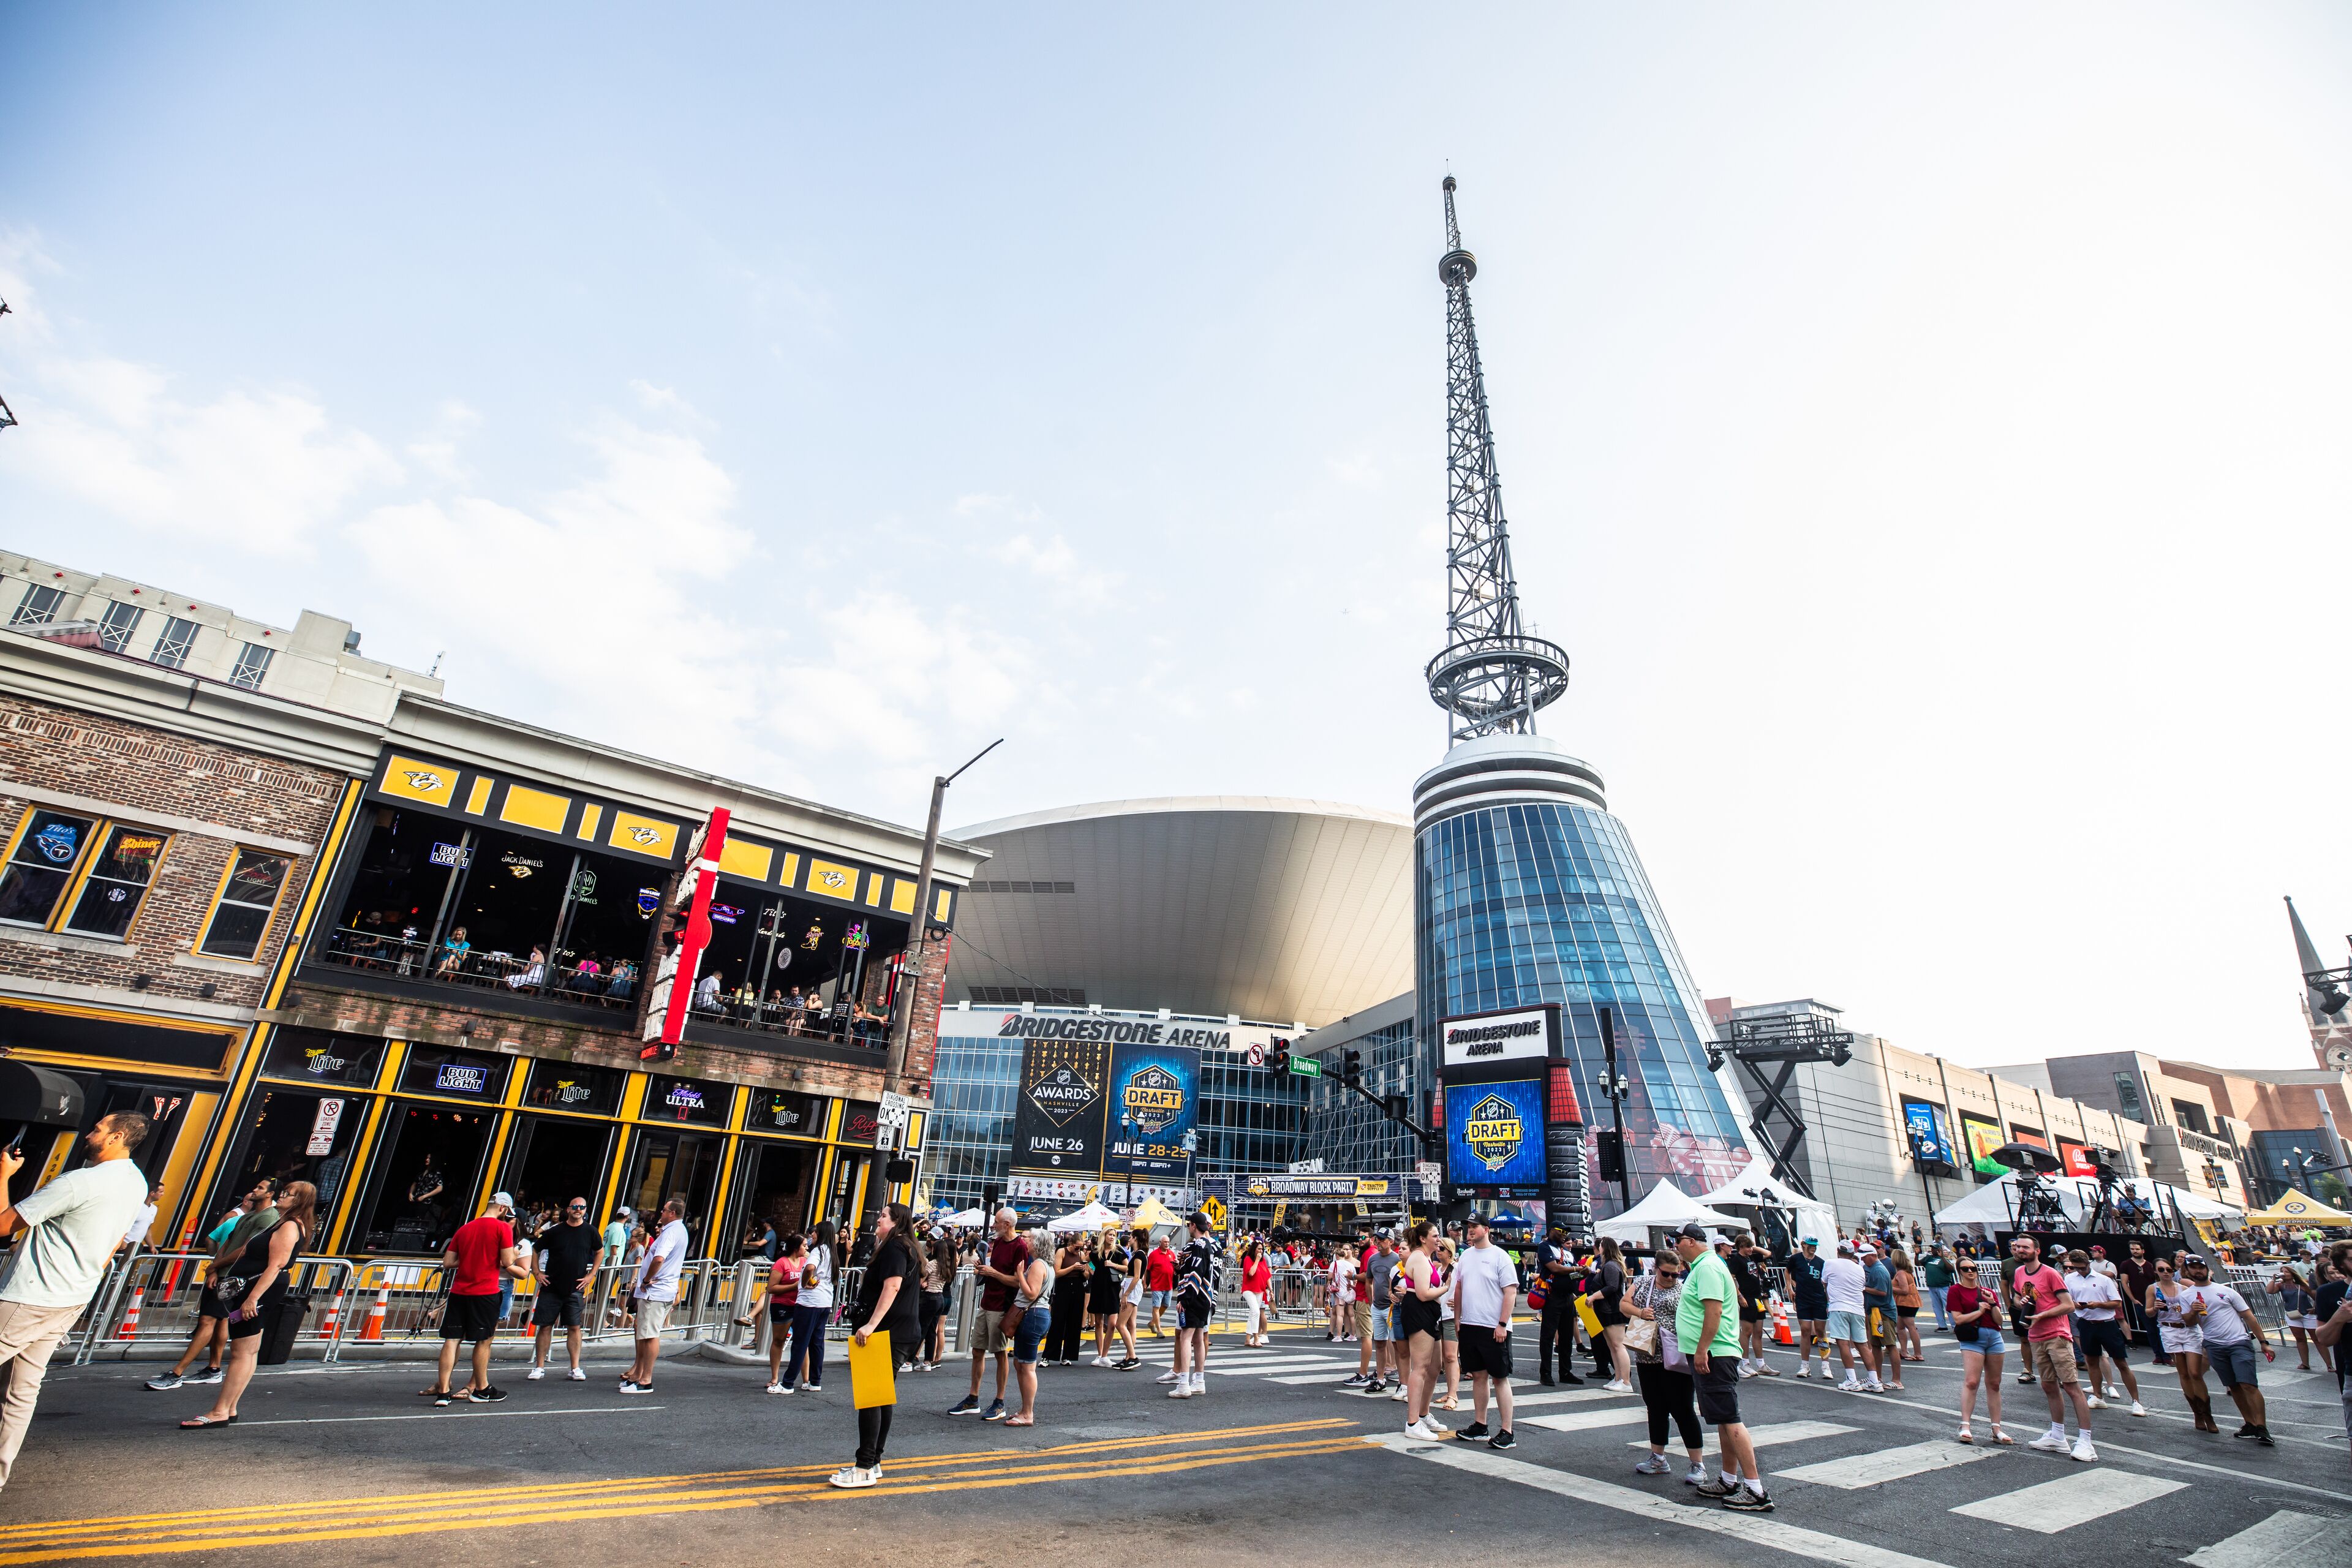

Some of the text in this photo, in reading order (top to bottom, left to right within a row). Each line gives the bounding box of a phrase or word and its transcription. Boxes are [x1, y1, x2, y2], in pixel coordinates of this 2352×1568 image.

[47, 824, 75, 834] Tito's
[121, 838, 161, 849] Shiner
[502, 855, 518, 864] JACK
[763, 908, 786, 919] Tit's
[758, 928, 785, 938] Handade
[556, 948, 576, 957] Tto's
[998, 1014, 1231, 1049] BRIDGESTONE ARENA
[1446, 1020, 1541, 1044] BRIDGESTONE
[1466, 1041, 1503, 1057] ARENA
[307, 1055, 344, 1072] Lite
[1294, 1057, 1317, 1076] Broadway
[447, 1068, 477, 1079] BUD
[439, 1077, 481, 1089] LIGHT
[561, 1085, 590, 1103] Lite
[886, 1093, 906, 1104] DIAGONAL
[1033, 1086, 1091, 1101] AWARDS
[1129, 1090, 1179, 1106] DRAFT
[666, 1095, 704, 1108] ULTRA
[884, 1099, 904, 1109] CROSSING
[775, 1110, 799, 1126] Lite
[880, 1107, 891, 1120] OK
[1472, 1123, 1517, 1138] DRAFT
[1028, 1136, 1084, 1151] JUNE 26
[1148, 1144, 1188, 1158] 28-29
[1289, 1158, 1323, 1173] NISSAN
[1250, 1177, 1267, 1189] 25
[1421, 1172, 1430, 1181] OK
[1271, 1182, 1353, 1193] BROADWAY BLOCK PARTY
[1576, 1136, 1594, 1246] BRIDGESTO
[1278, 1207, 1284, 1216] GO
[1213, 1257, 1223, 1269] 88
[1809, 1265, 1820, 1279] LB
